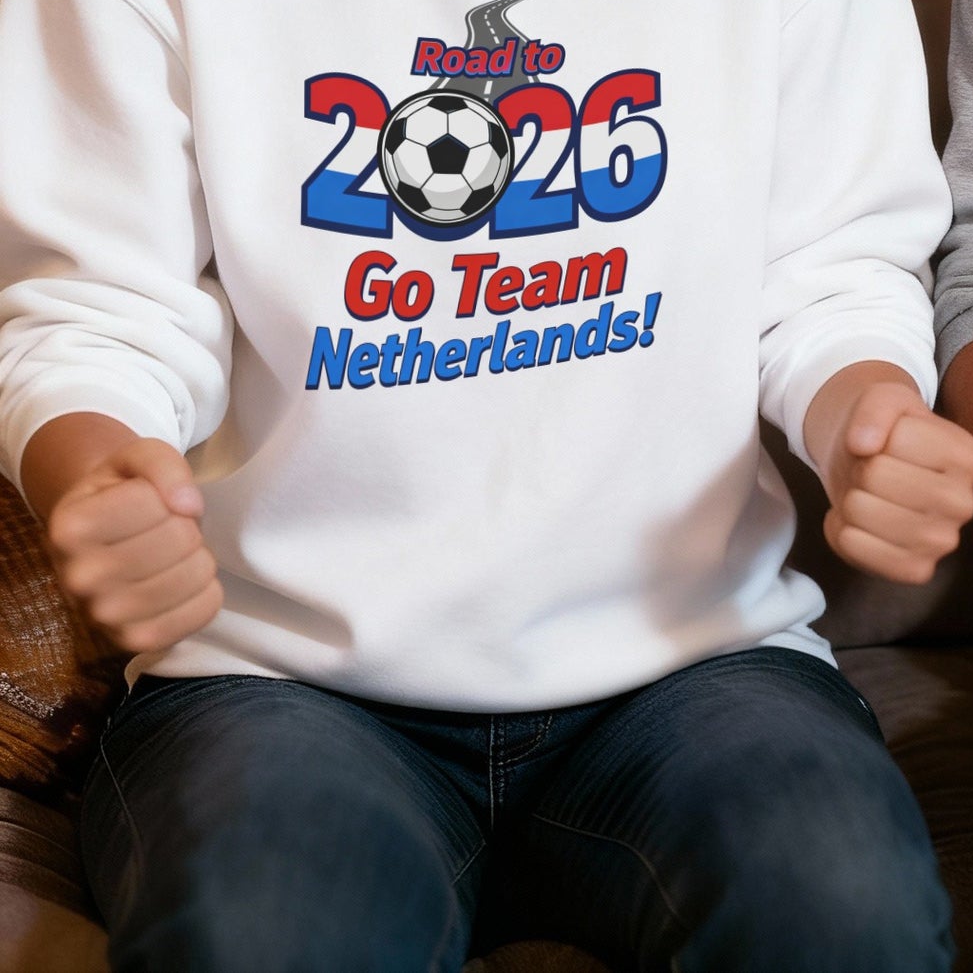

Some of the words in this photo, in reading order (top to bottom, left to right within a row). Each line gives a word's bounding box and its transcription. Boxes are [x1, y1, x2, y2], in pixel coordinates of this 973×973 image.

[411, 37, 519, 78] Road
[522, 39, 565, 76] to
[344, 250, 434, 321] Go
[452, 247, 628, 318] Team
[305, 292, 662, 390] Netherlands!
